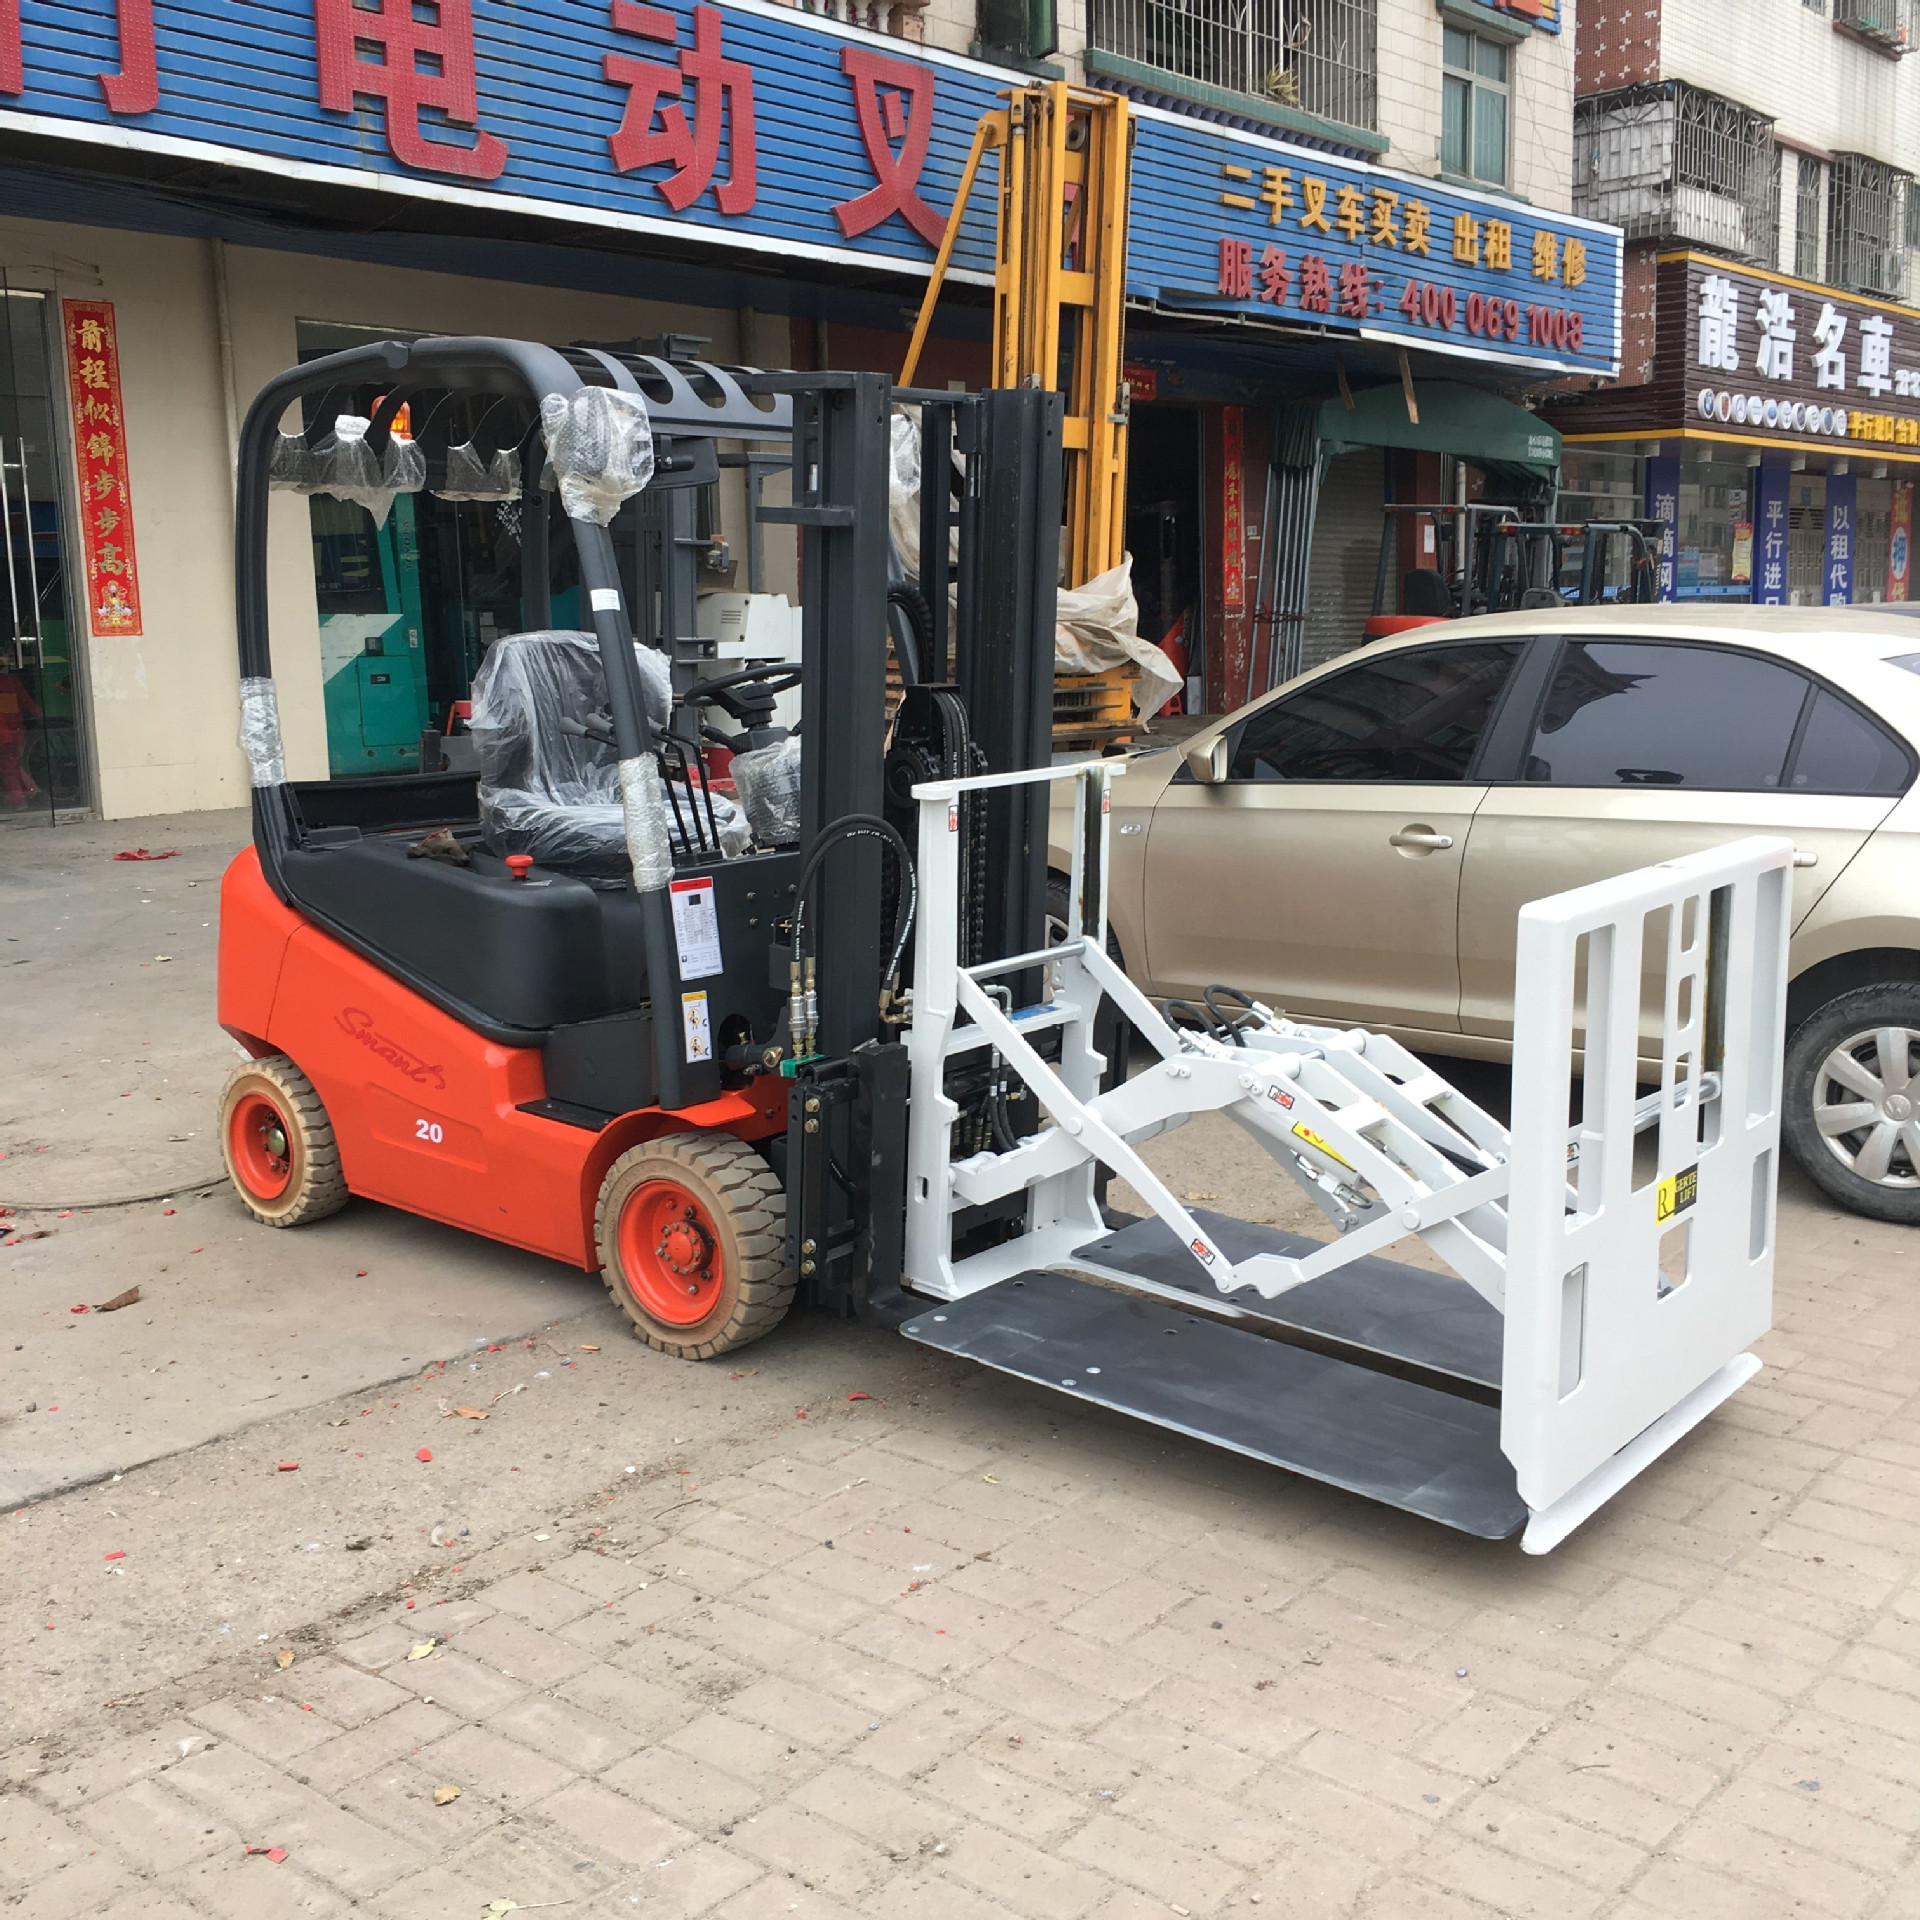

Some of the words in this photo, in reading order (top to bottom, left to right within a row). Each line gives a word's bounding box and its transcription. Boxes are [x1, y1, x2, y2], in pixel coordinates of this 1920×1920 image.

[0, 0, 1083, 249] 电动叉
[1219, 163, 1432, 258] 二手叉车买卖
[1452, 212, 1513, 271] 出租
[1531, 229, 1588, 290] 维修
[1398, 277, 1457, 330] 400
[1465, 291, 1520, 341] 069
[1525, 302, 1584, 350] 1008
[1698, 274, 1894, 398] 龍浩名車
[415, 1118, 443, 1144] 20
[1680, 1185, 1696, 1203] LIFT
